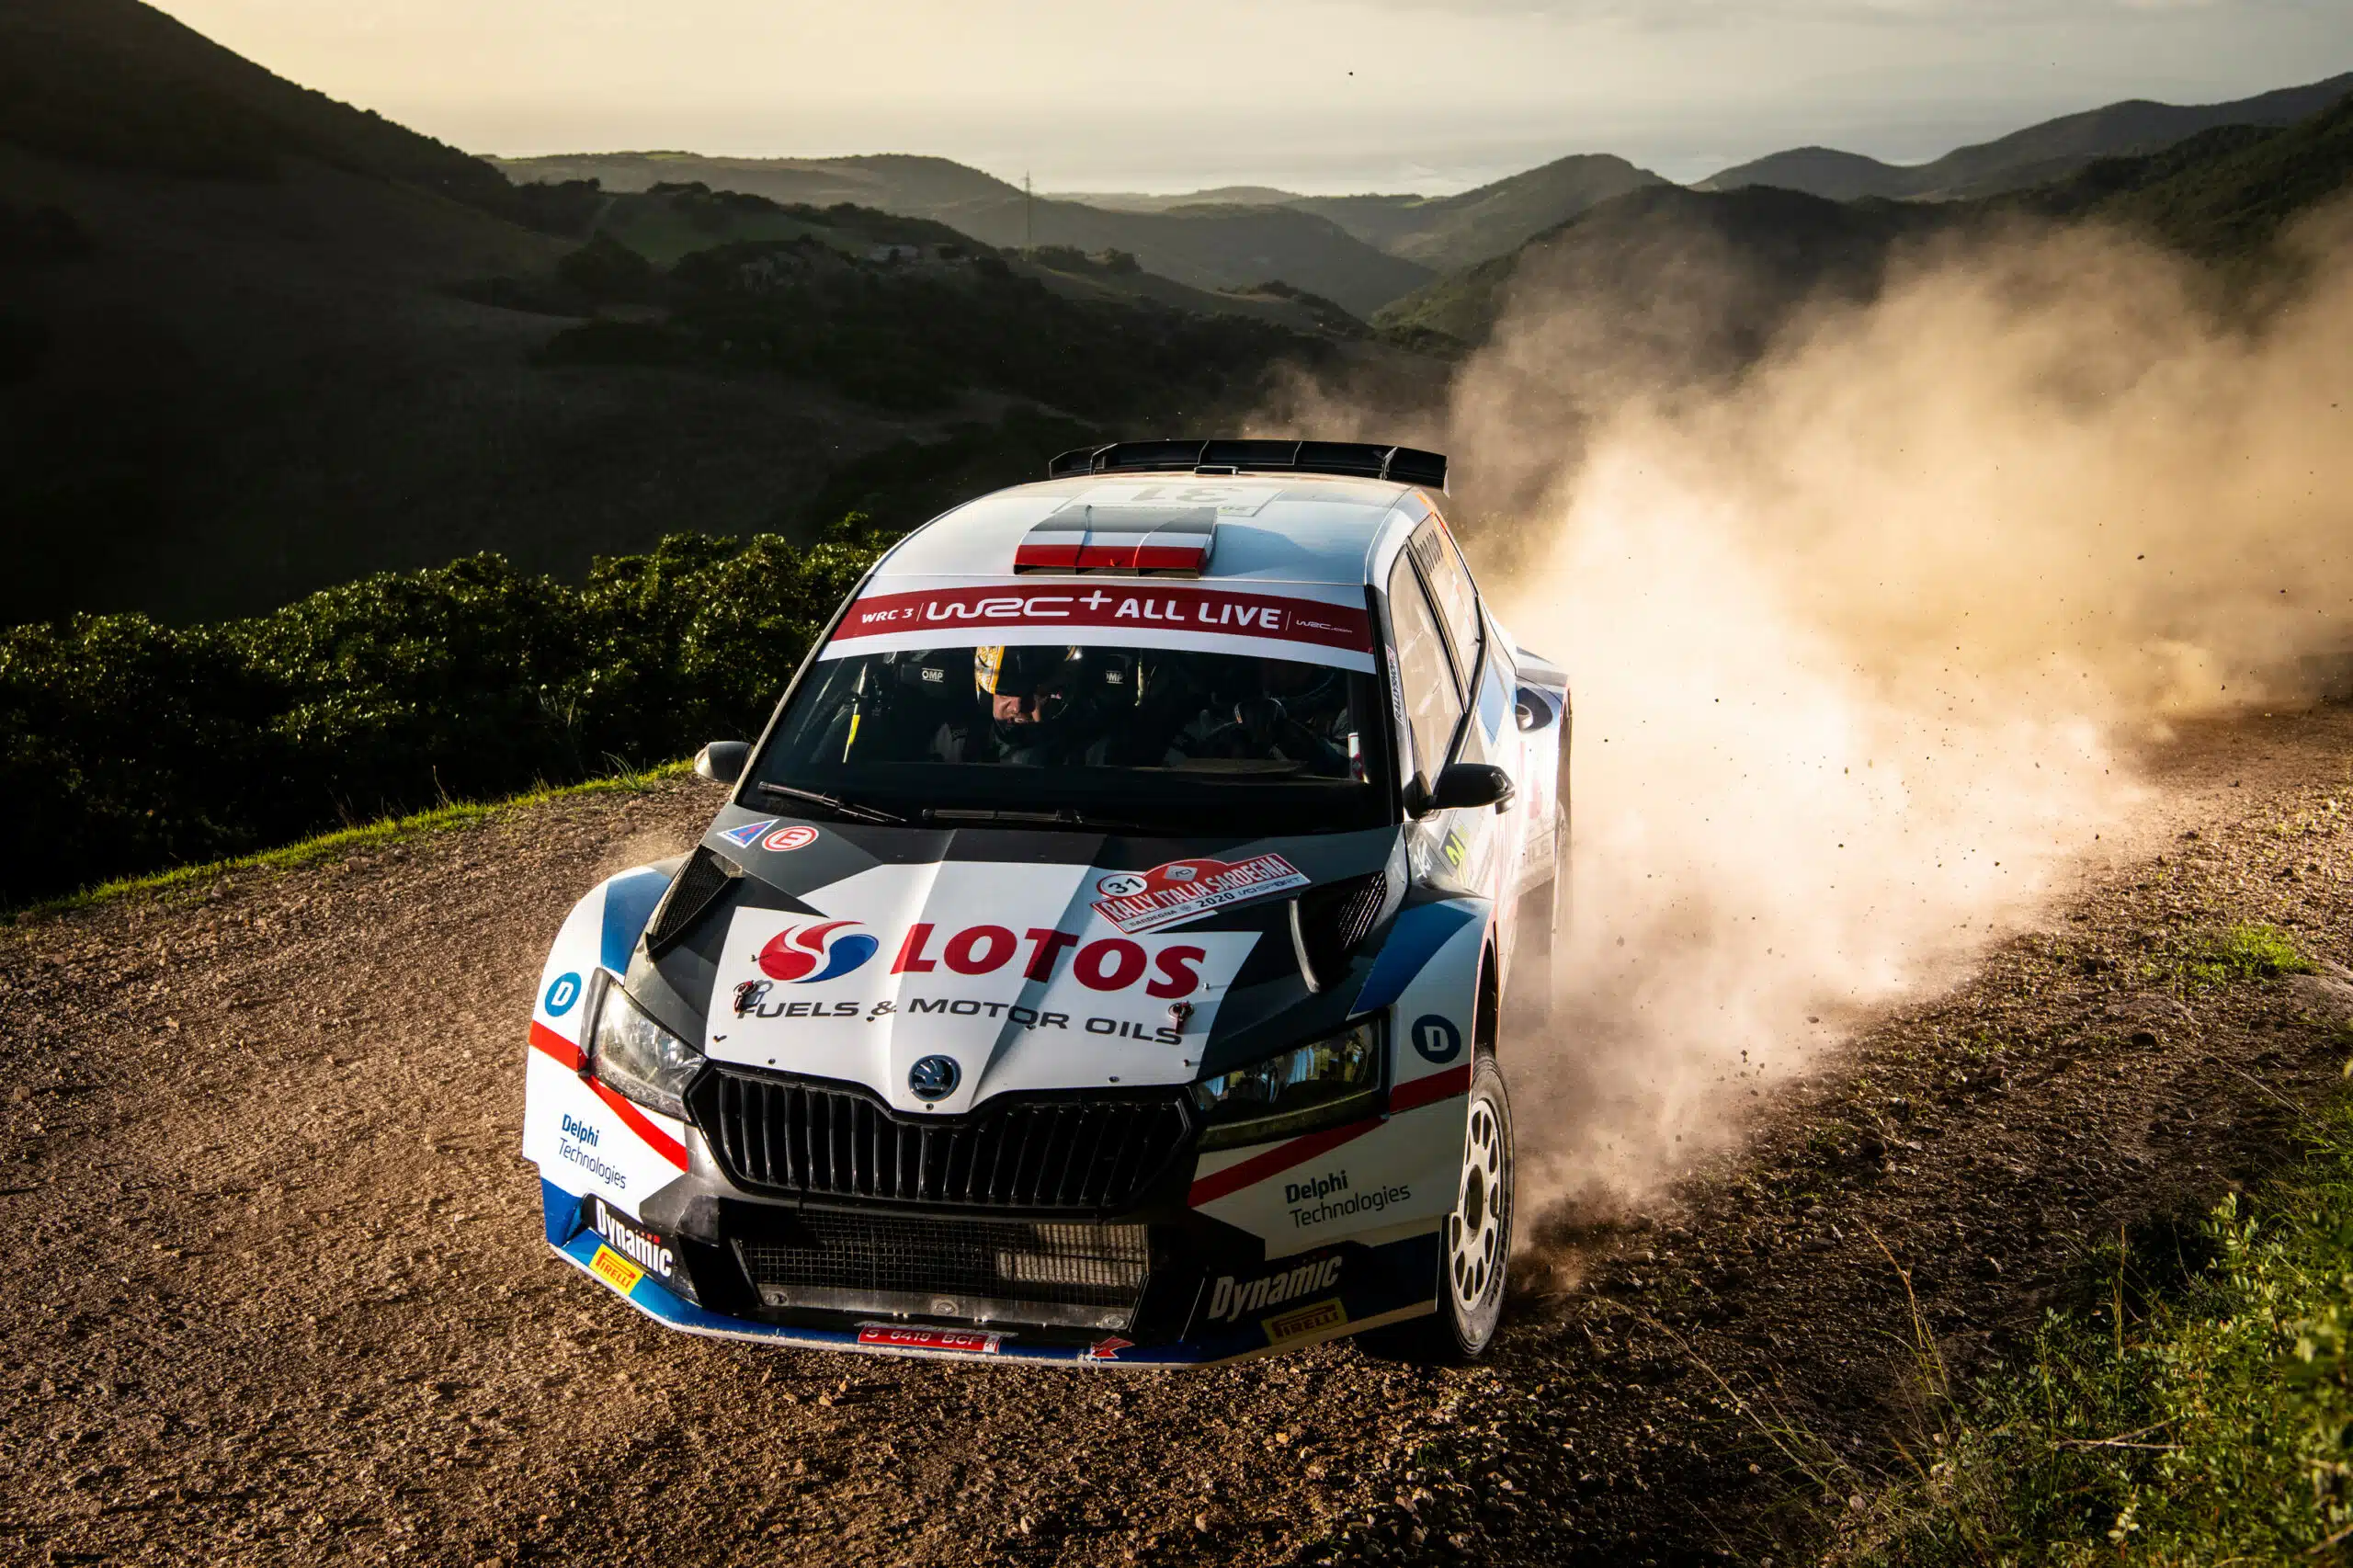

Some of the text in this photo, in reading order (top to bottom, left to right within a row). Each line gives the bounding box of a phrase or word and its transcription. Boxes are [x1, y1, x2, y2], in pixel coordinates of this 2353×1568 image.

[861, 609, 899, 624] WRC
[902, 608, 914, 619] 3
[1115, 597, 1185, 620] ALL
[1198, 602, 1282, 630] LIVE
[922, 669, 944, 681] OMP
[773, 831, 808, 846] E
[1104, 855, 1295, 922] RALLY ITALIA SARDEGNA
[1108, 877, 1143, 894] 31
[1129, 910, 1177, 926] SARDEGNA
[1198, 892, 1235, 908] 2020
[890, 923, 1206, 999] LOTOS
[551, 981, 574, 1006] D
[870, 1000, 896, 1016] &
[908, 998, 1070, 1029] MOTOR
[1085, 1017, 1183, 1046] OILS
[1424, 1026, 1449, 1051] D
[561, 1114, 600, 1148] Delphi
[558, 1136, 628, 1190] Technologies
[1285, 1169, 1348, 1205] Delphi
[1290, 1184, 1412, 1230] Technologies
[596, 1199, 673, 1278] Dynamic
[595, 1252, 636, 1289] PIRELLI
[1207, 1256, 1342, 1323] Dynamic
[866, 1329, 880, 1338] S
[941, 1334, 983, 1346] BCF
[1271, 1303, 1339, 1339] PIRELLI
